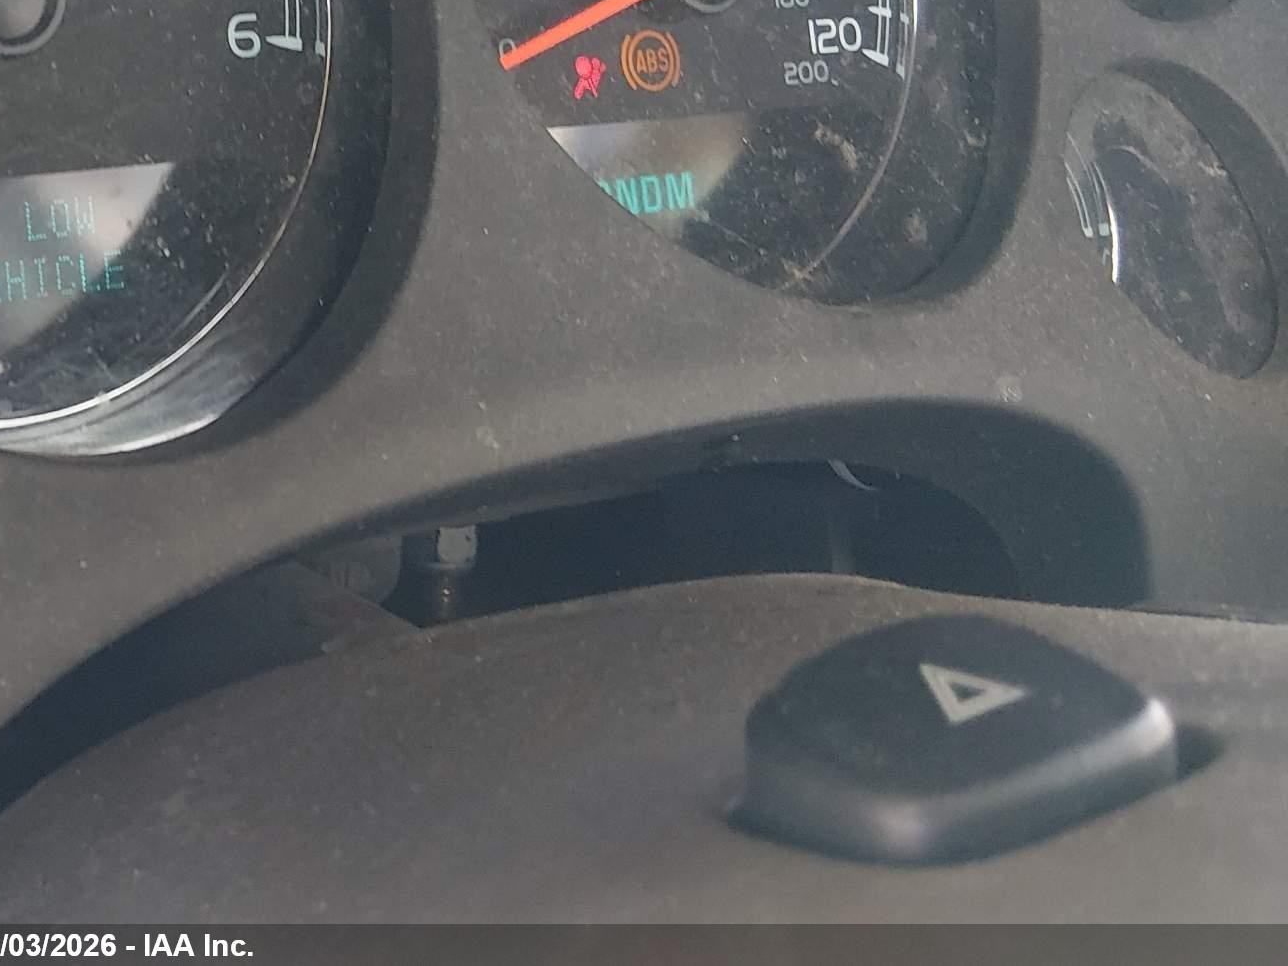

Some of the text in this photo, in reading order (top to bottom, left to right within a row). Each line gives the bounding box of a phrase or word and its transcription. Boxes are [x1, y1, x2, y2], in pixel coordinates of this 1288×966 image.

[226, 13, 262, 59] 6
[807, 16, 863, 55] 120
[636, 47, 669, 75] ABS
[783, 59, 830, 85] 200
[597, 170, 695, 215] NDM
[23, 196, 96, 243] LOW
